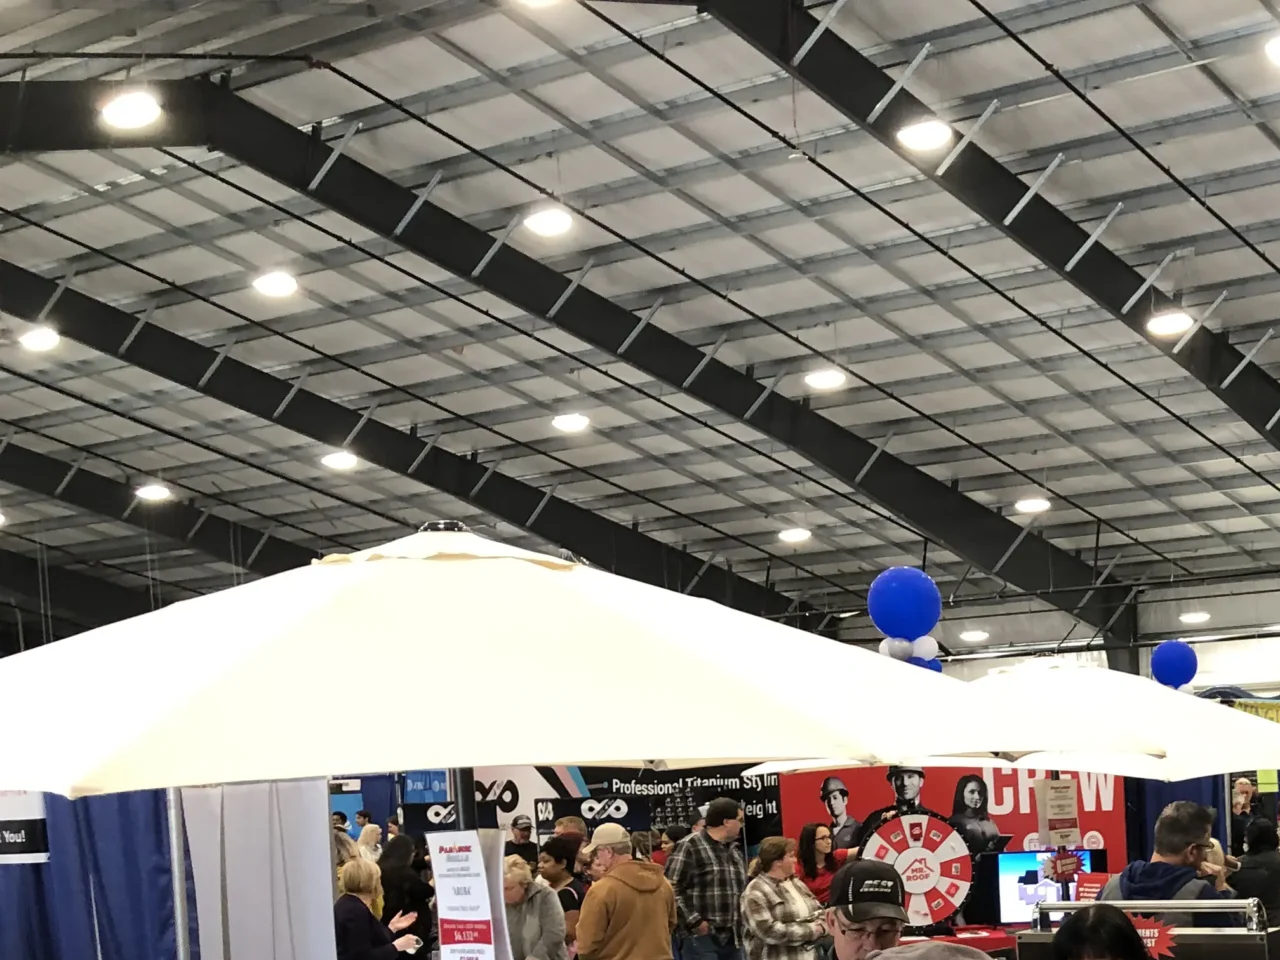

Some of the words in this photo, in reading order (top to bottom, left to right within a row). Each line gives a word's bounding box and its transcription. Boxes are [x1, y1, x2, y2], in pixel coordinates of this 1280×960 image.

[612, 778, 683, 796] Professional
[685, 774, 740, 789] Titanium
[743, 773, 778, 791] Stylin
[983, 767, 1115, 815] CRW
[741, 799, 777, 818] eight
[2, 829, 26, 843] You!
[906, 873, 930, 882] ROOF
